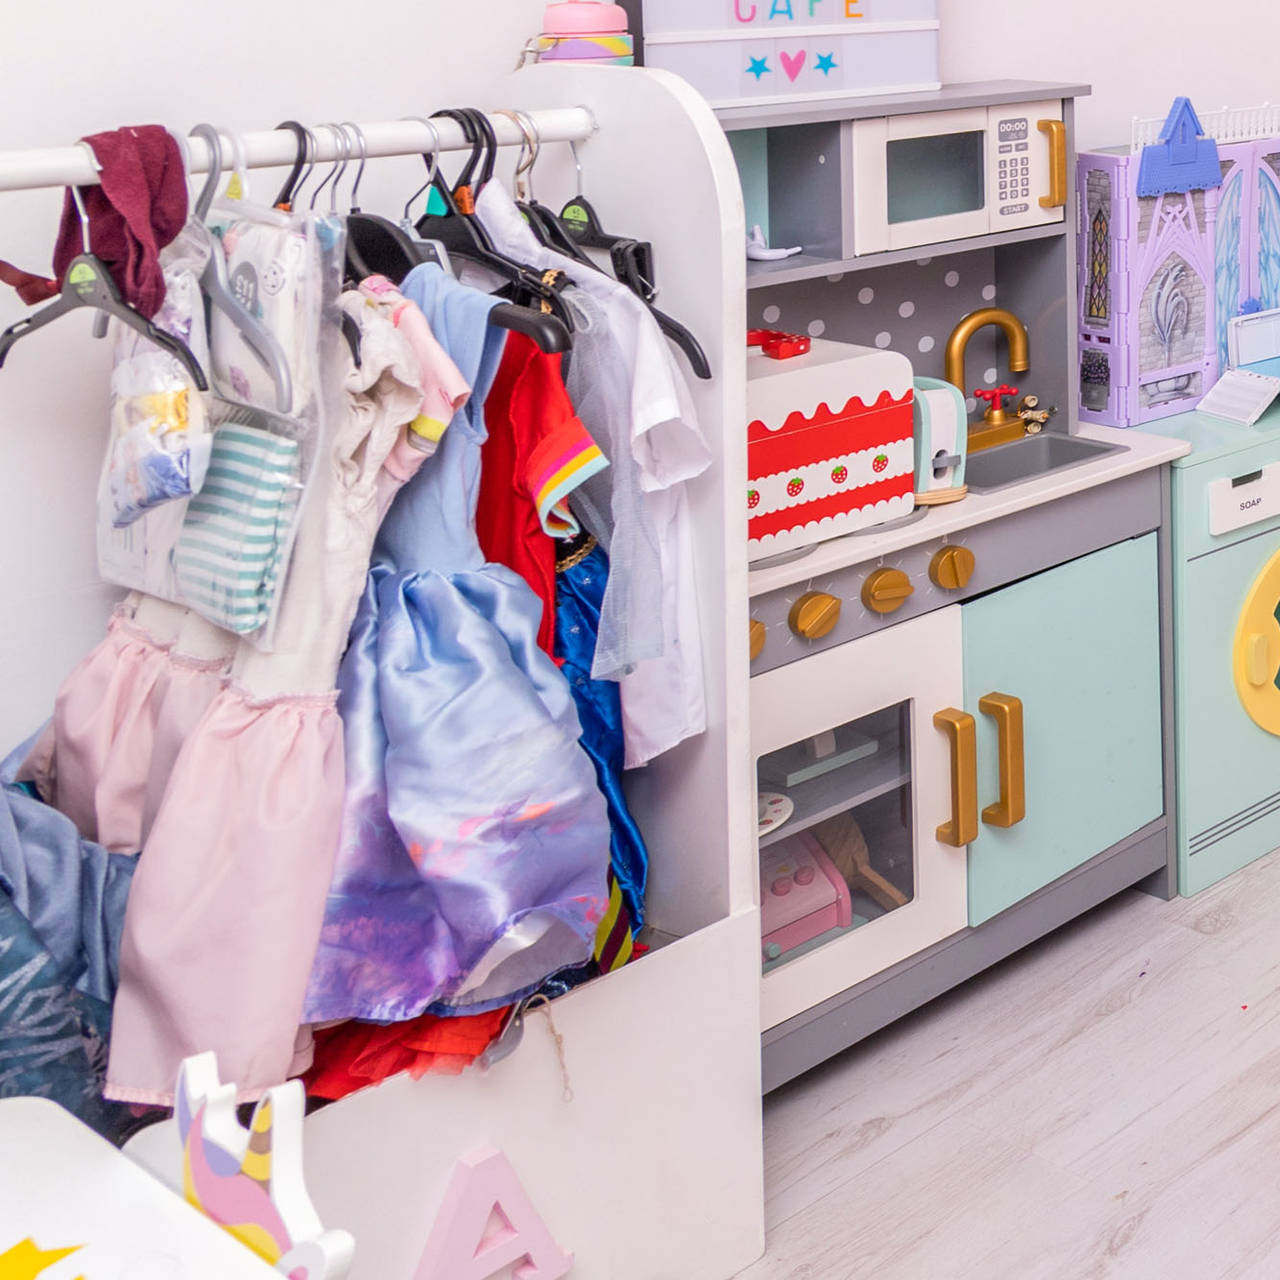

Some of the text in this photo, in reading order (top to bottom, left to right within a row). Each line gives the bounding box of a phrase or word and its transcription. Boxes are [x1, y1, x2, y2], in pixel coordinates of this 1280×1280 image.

[1000, 121, 1027, 132] 00:00
[1002, 205, 1026, 215] START
[1239, 497, 1262, 511] SOAP
